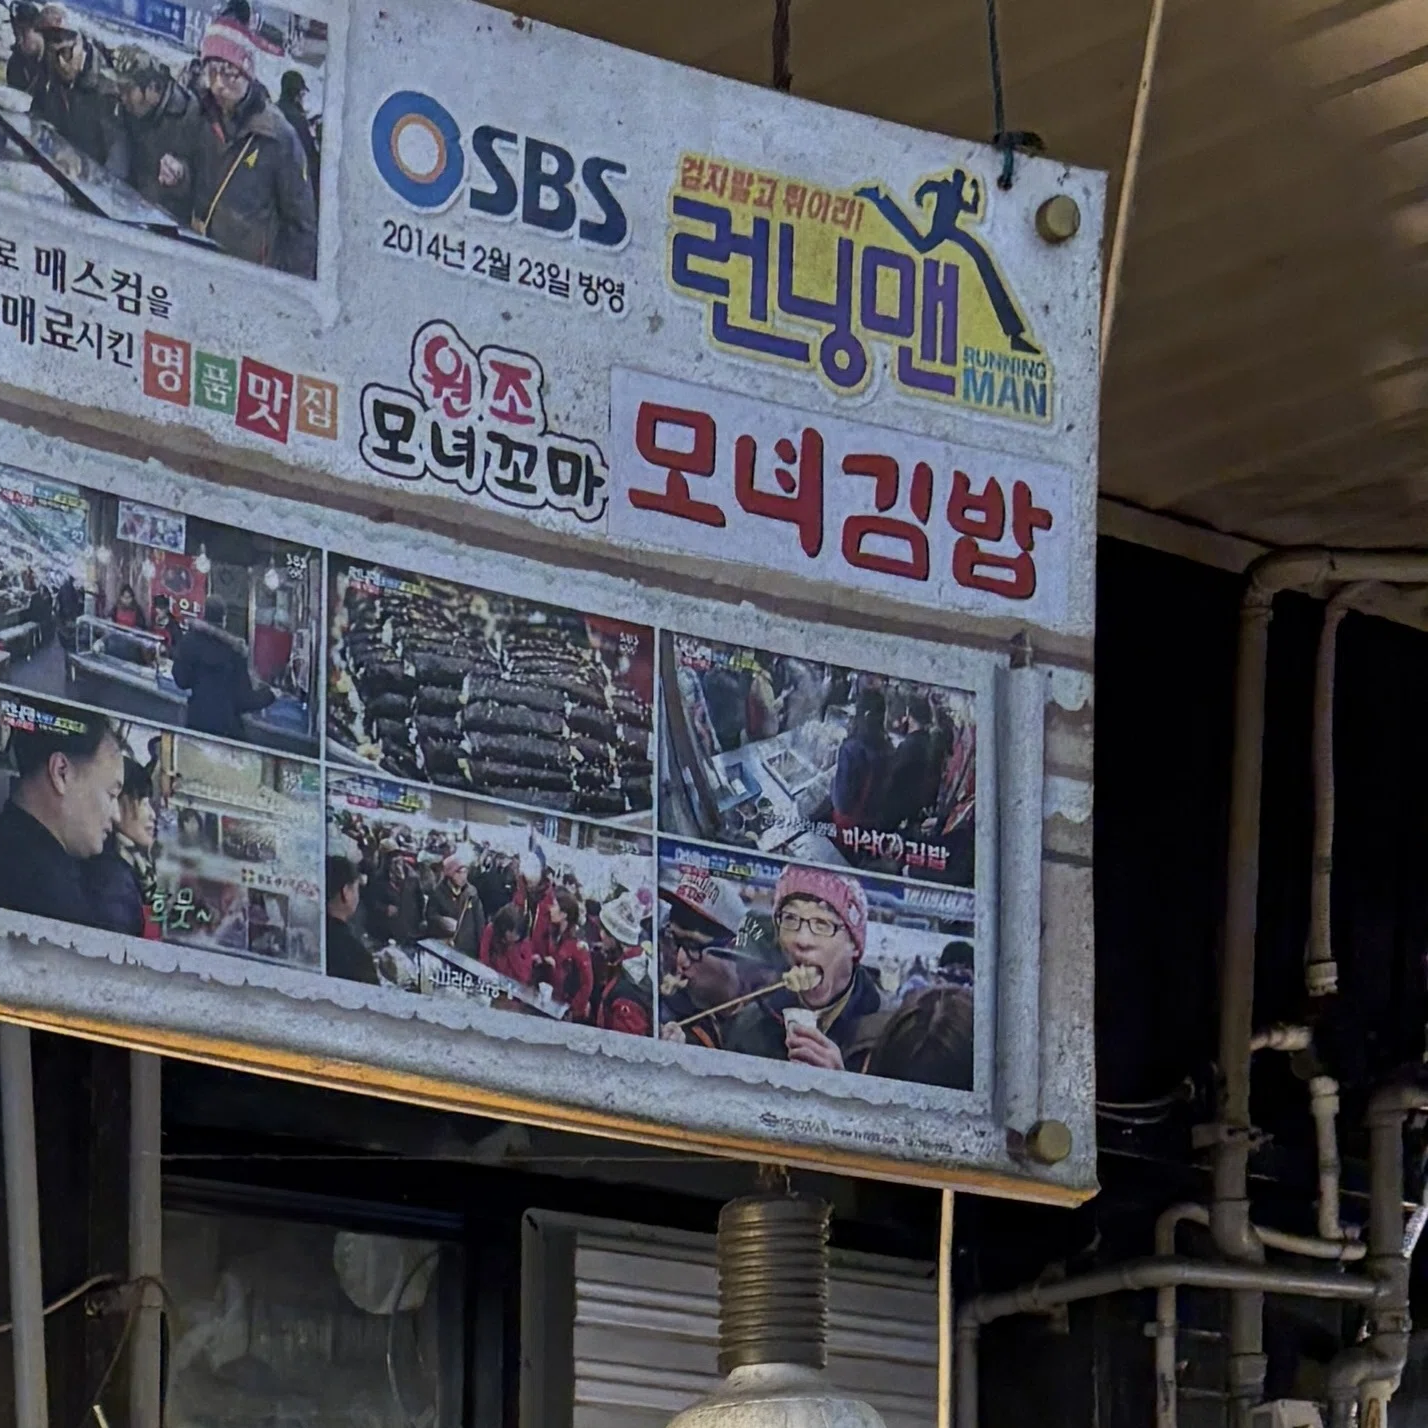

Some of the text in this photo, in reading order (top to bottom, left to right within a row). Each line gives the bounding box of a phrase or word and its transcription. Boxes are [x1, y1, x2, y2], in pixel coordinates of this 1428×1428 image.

[469, 125, 628, 247] SBS
[34, 245, 174, 320] 매스컴을
[383, 219, 625, 314] 2014년 2월 23일 방영
[672, 195, 960, 397] 런닝맨
[0, 293, 134, 369] 매료시킨
[962, 346, 1048, 380] RUNNING
[420, 334, 537, 427] 원조
[962, 369, 1048, 417] MAN
[372, 397, 607, 507] 모녀꼬마
[626, 400, 1054, 600] 모녀김밥
